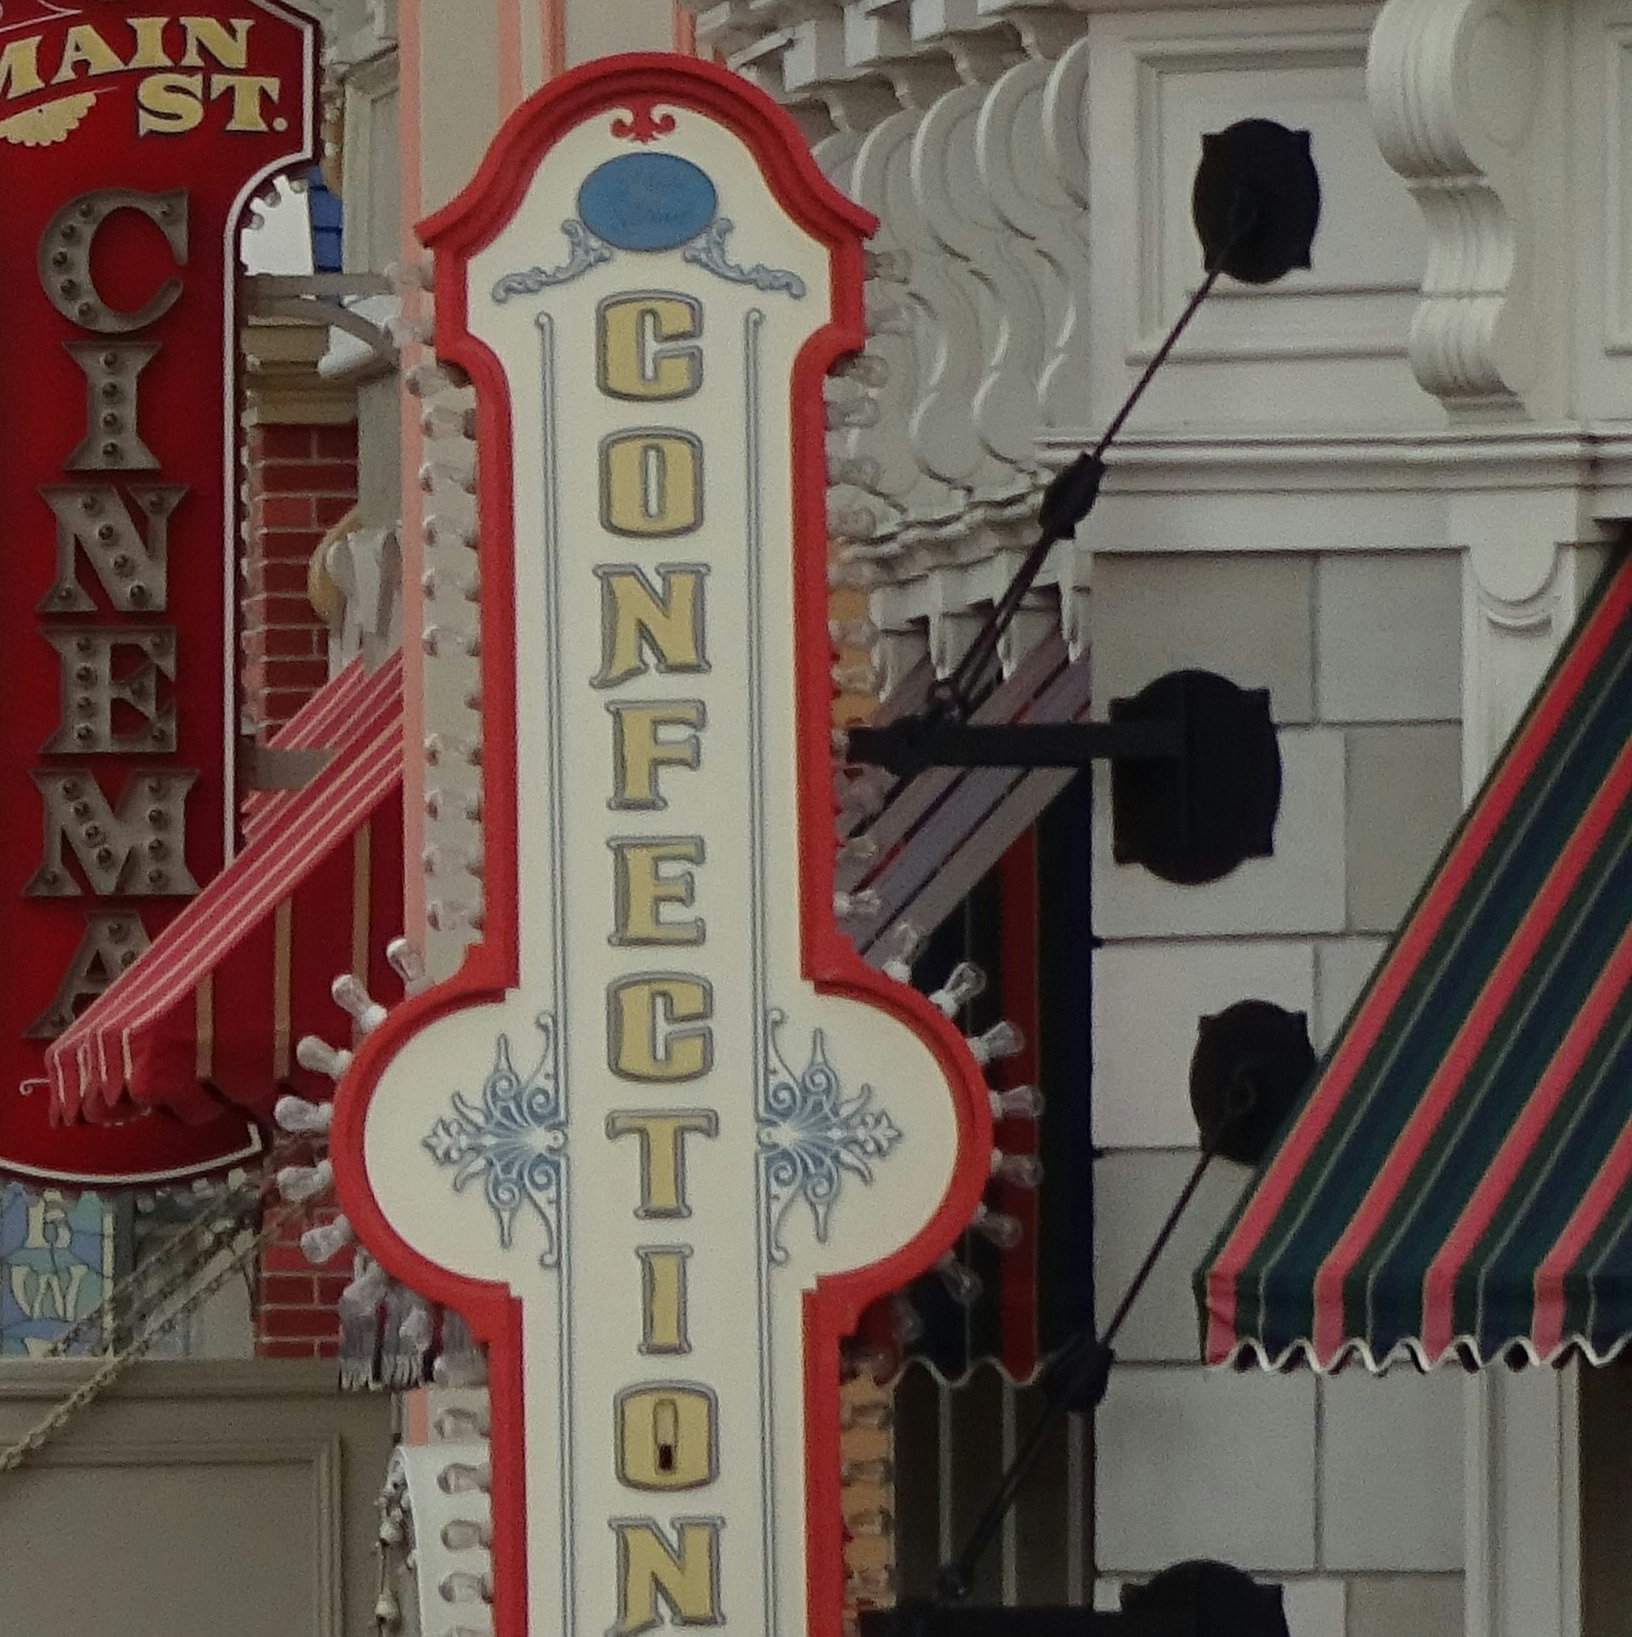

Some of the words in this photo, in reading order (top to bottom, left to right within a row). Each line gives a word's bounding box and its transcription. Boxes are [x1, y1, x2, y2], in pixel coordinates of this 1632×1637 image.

[138, 72, 290, 138] ST.
[21, 187, 203, 1041] CINEMA
[592, 287, 729, 1637] CONFECTION
